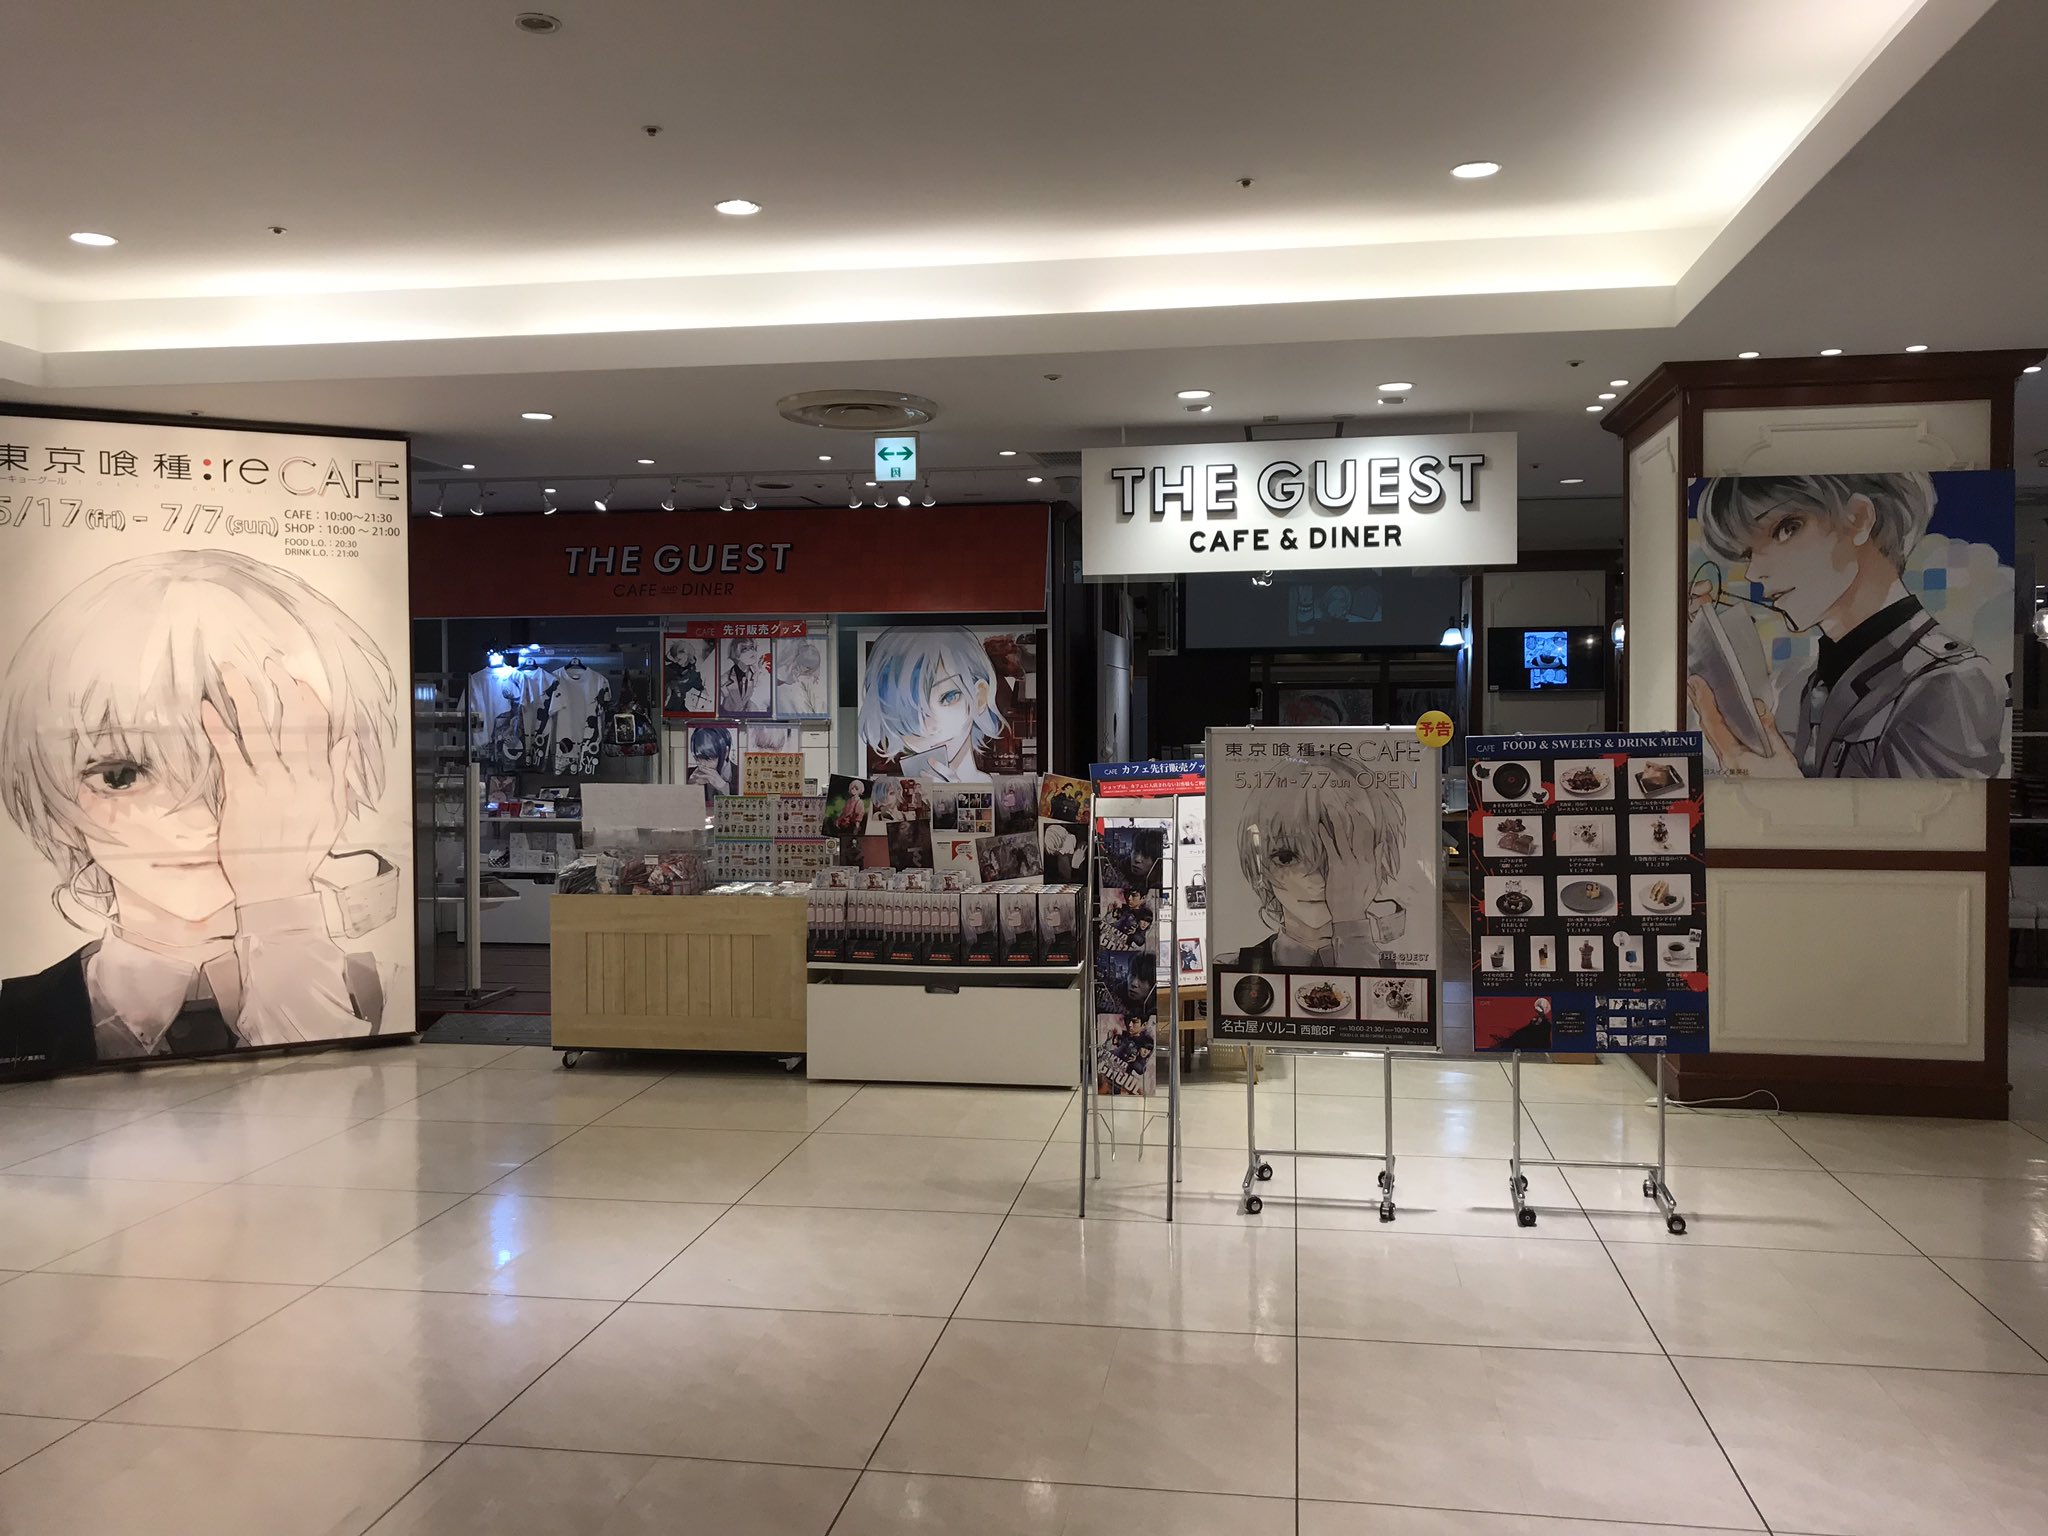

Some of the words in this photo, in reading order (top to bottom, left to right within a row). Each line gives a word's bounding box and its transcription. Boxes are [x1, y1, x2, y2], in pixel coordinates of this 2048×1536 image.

[278, 456, 400, 501] CAFE
[1111, 464, 1238, 516] THE
[1256, 454, 1486, 513] GUEST
[160, 503, 279, 537] 7/7(sun)
[284, 509, 313, 520] CAFE
[284, 523, 315, 534] SHOP
[327, 525, 356, 535] 10:00
[372, 527, 401, 537] 21:00
[284, 538, 309, 547] FOOD
[335, 540, 358, 549] 20:30
[1190, 528, 1270, 553] CAFE
[1280, 527, 1298, 550] &
[1309, 525, 1403, 549] DINER
[285, 548, 311, 557] DRINK
[337, 550, 359, 558] 21:00
[564, 546, 642, 577] THE
[653, 543, 792, 575] GUEST
[614, 584, 657, 598] CAFE
[681, 582, 735, 596] DINER
[723, 623, 803, 636] 先行販売グッズ
[1419, 721, 1447, 737] 予告
[1358, 740, 1421, 762] CAFE
[1477, 744, 1496, 753] CAFE
[1502, 740, 1537, 751] FOOD
[1539, 740, 1550, 750] &
[1551, 738, 1602, 749] SWEETS
[1604, 738, 1615, 748] &
[1617, 737, 1658, 748] DRINK
[1659, 736, 1698, 747] MENU
[1356, 770, 1418, 790] OPEN
[1221, 1019, 1297, 1035] 名古屋パルコ
[1301, 1024, 1337, 1037] 西館8F
